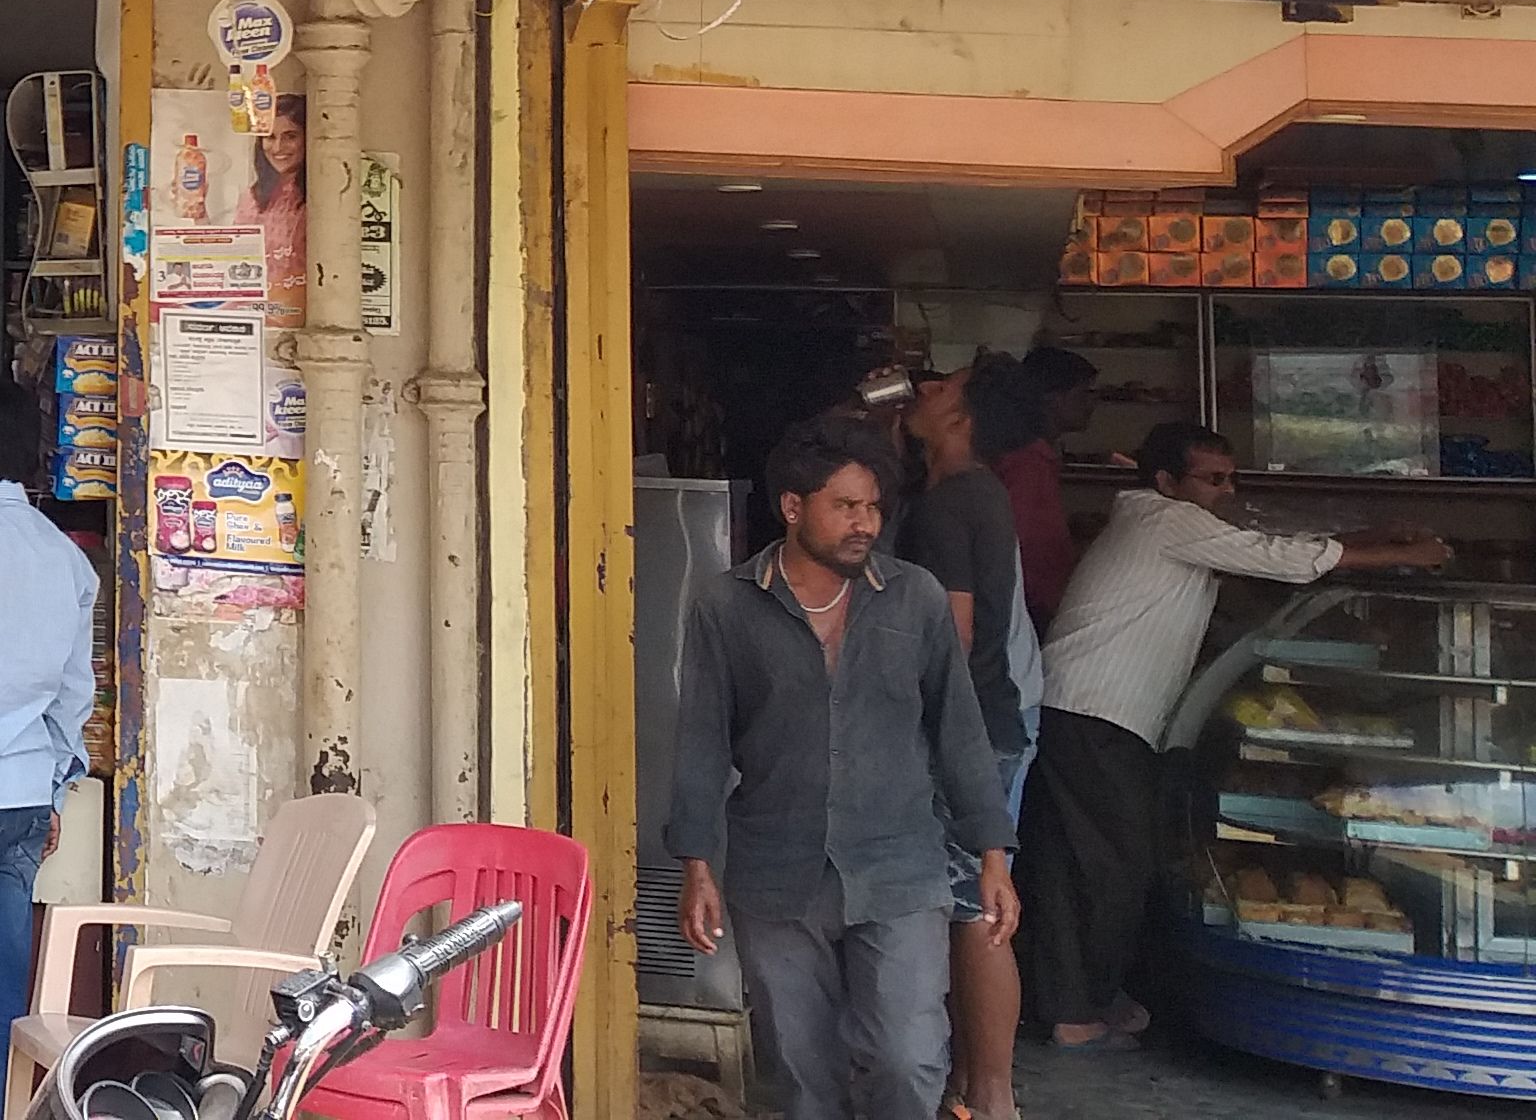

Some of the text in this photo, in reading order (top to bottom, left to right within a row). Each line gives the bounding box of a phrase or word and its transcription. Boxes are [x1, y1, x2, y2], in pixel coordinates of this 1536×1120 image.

[238, 17, 273, 30] Max
[75, 344, 100, 356] ACT
[76, 400, 102, 413] ACT
[77, 453, 102, 466] ACT
